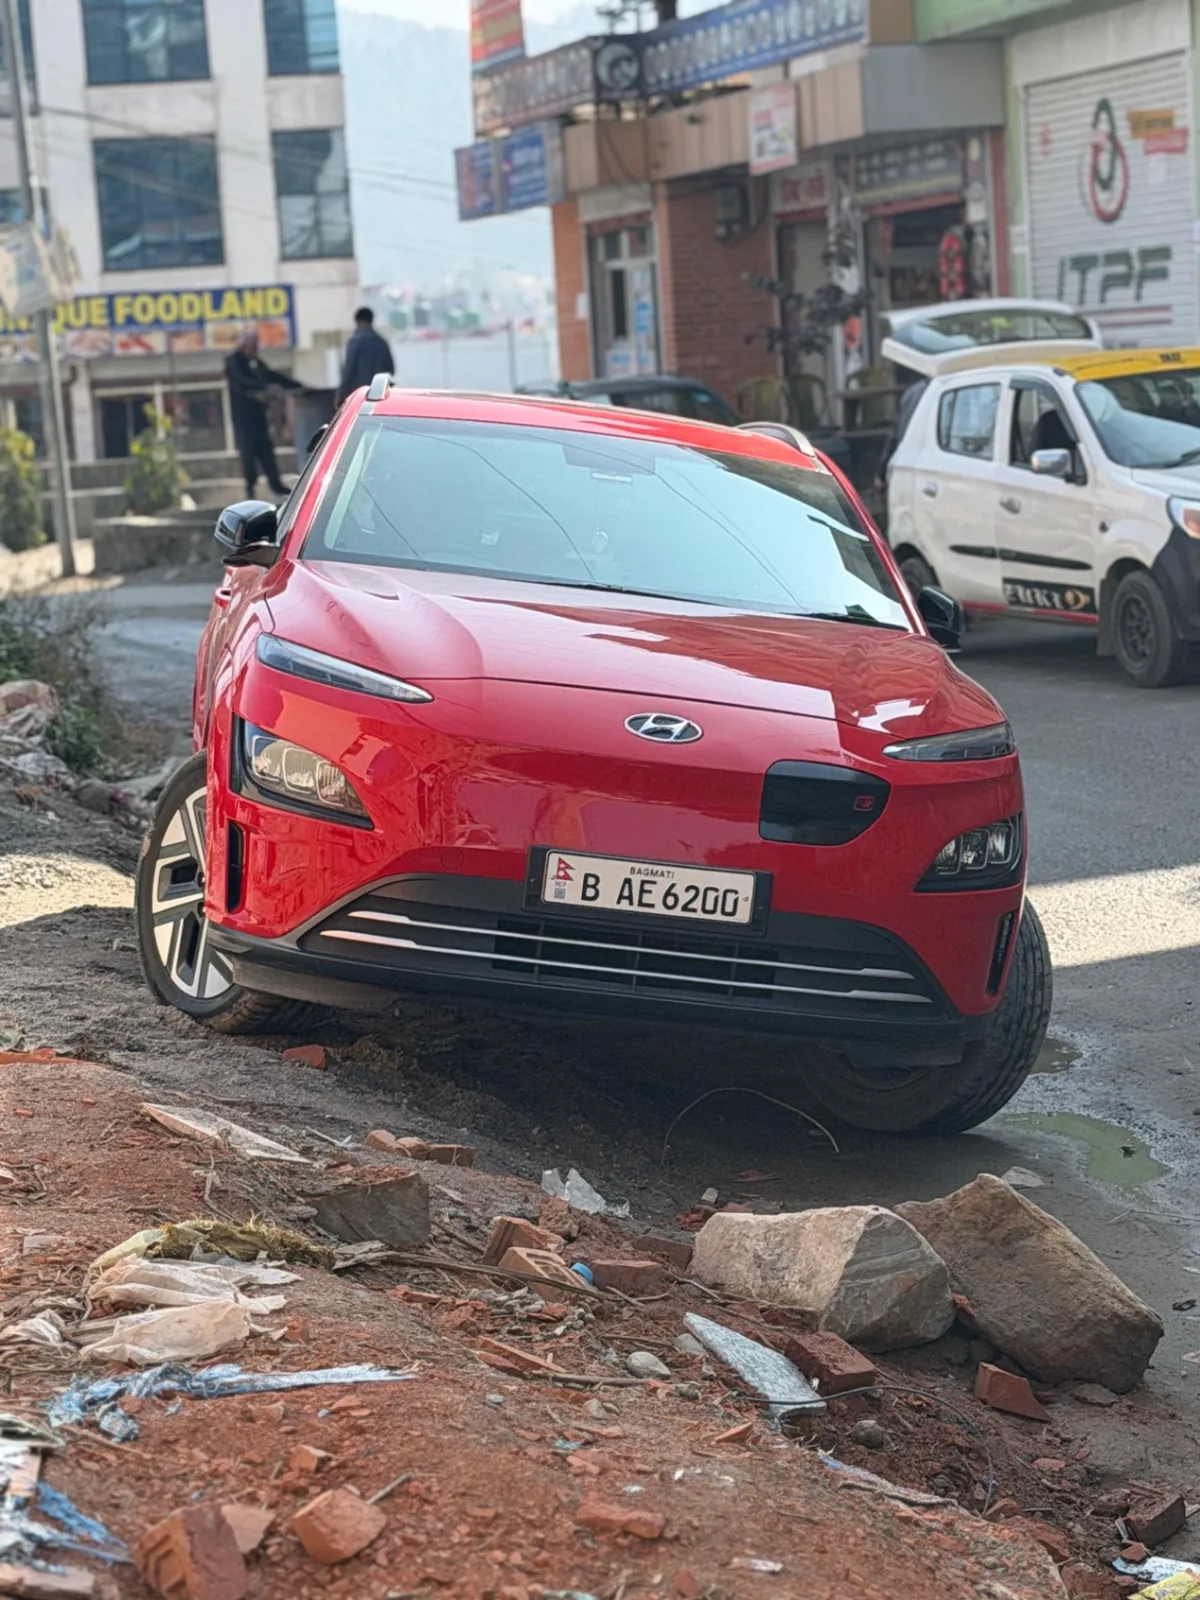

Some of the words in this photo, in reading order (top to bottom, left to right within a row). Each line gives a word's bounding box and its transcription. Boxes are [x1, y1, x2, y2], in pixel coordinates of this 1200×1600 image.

[114, 287, 288, 325] FOODLAND
[581, 872, 601, 902] B
[629, 866, 675, 879] BAGMATI
